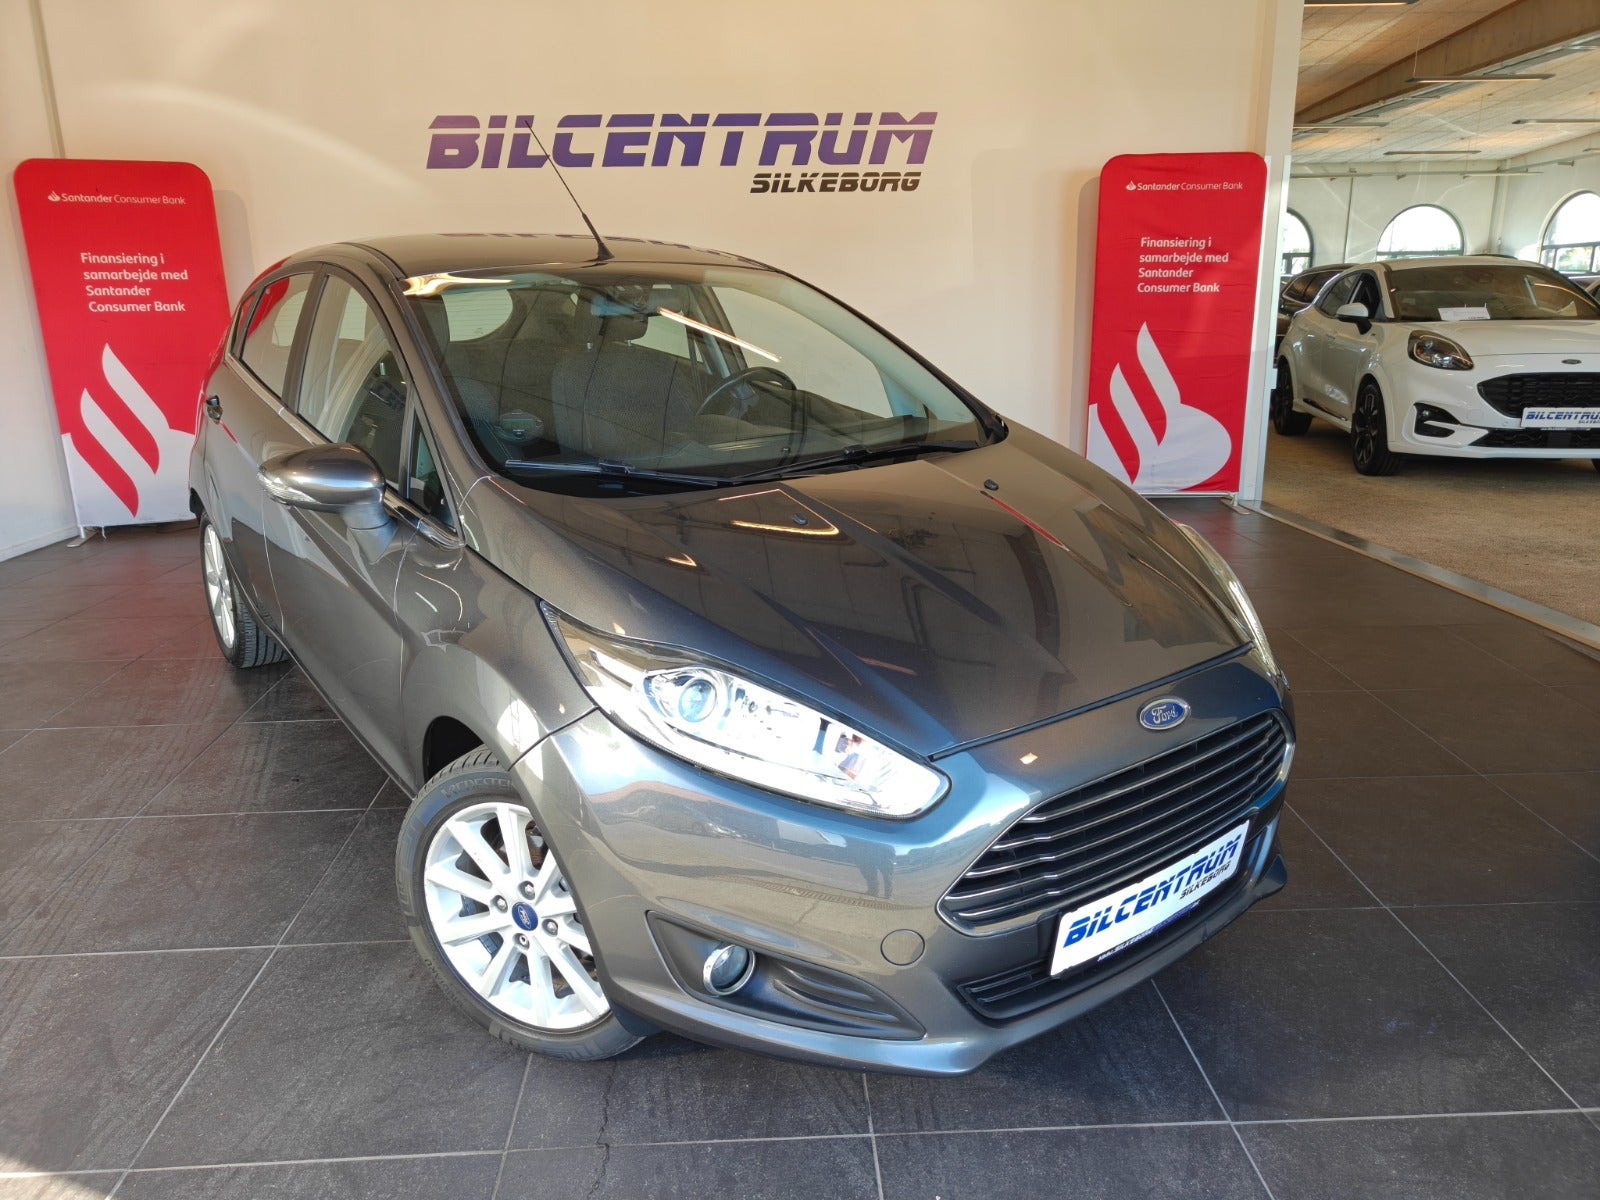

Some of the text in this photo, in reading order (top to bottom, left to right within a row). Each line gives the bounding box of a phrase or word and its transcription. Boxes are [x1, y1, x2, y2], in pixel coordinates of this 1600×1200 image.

[426, 112, 937, 169] BILCENTRUM
[750, 171, 922, 194] SILKEBORG
[1137, 181, 1243, 191] Santander Consumer Bank
[61, 192, 186, 205] Santander Consumer Bank
[1140, 237, 1212, 249] Finansiering i
[80, 252, 165, 266] Finansiering i
[1139, 252, 1229, 265] samarbejde med
[83, 269, 188, 282] samarbejde med
[1138, 267, 1194, 278] Santander
[85, 285, 151, 296] Santander
[1137, 282, 1220, 293] Consumer Bank
[88, 301, 186, 313] Consumer Bank
[1525, 411, 1600, 420] BILCENTRU
[1151, 704, 1179, 724] Ford
[1179, 861, 1232, 900] SILKEBORG
[1063, 833, 1242, 948] BILCENTRUM
